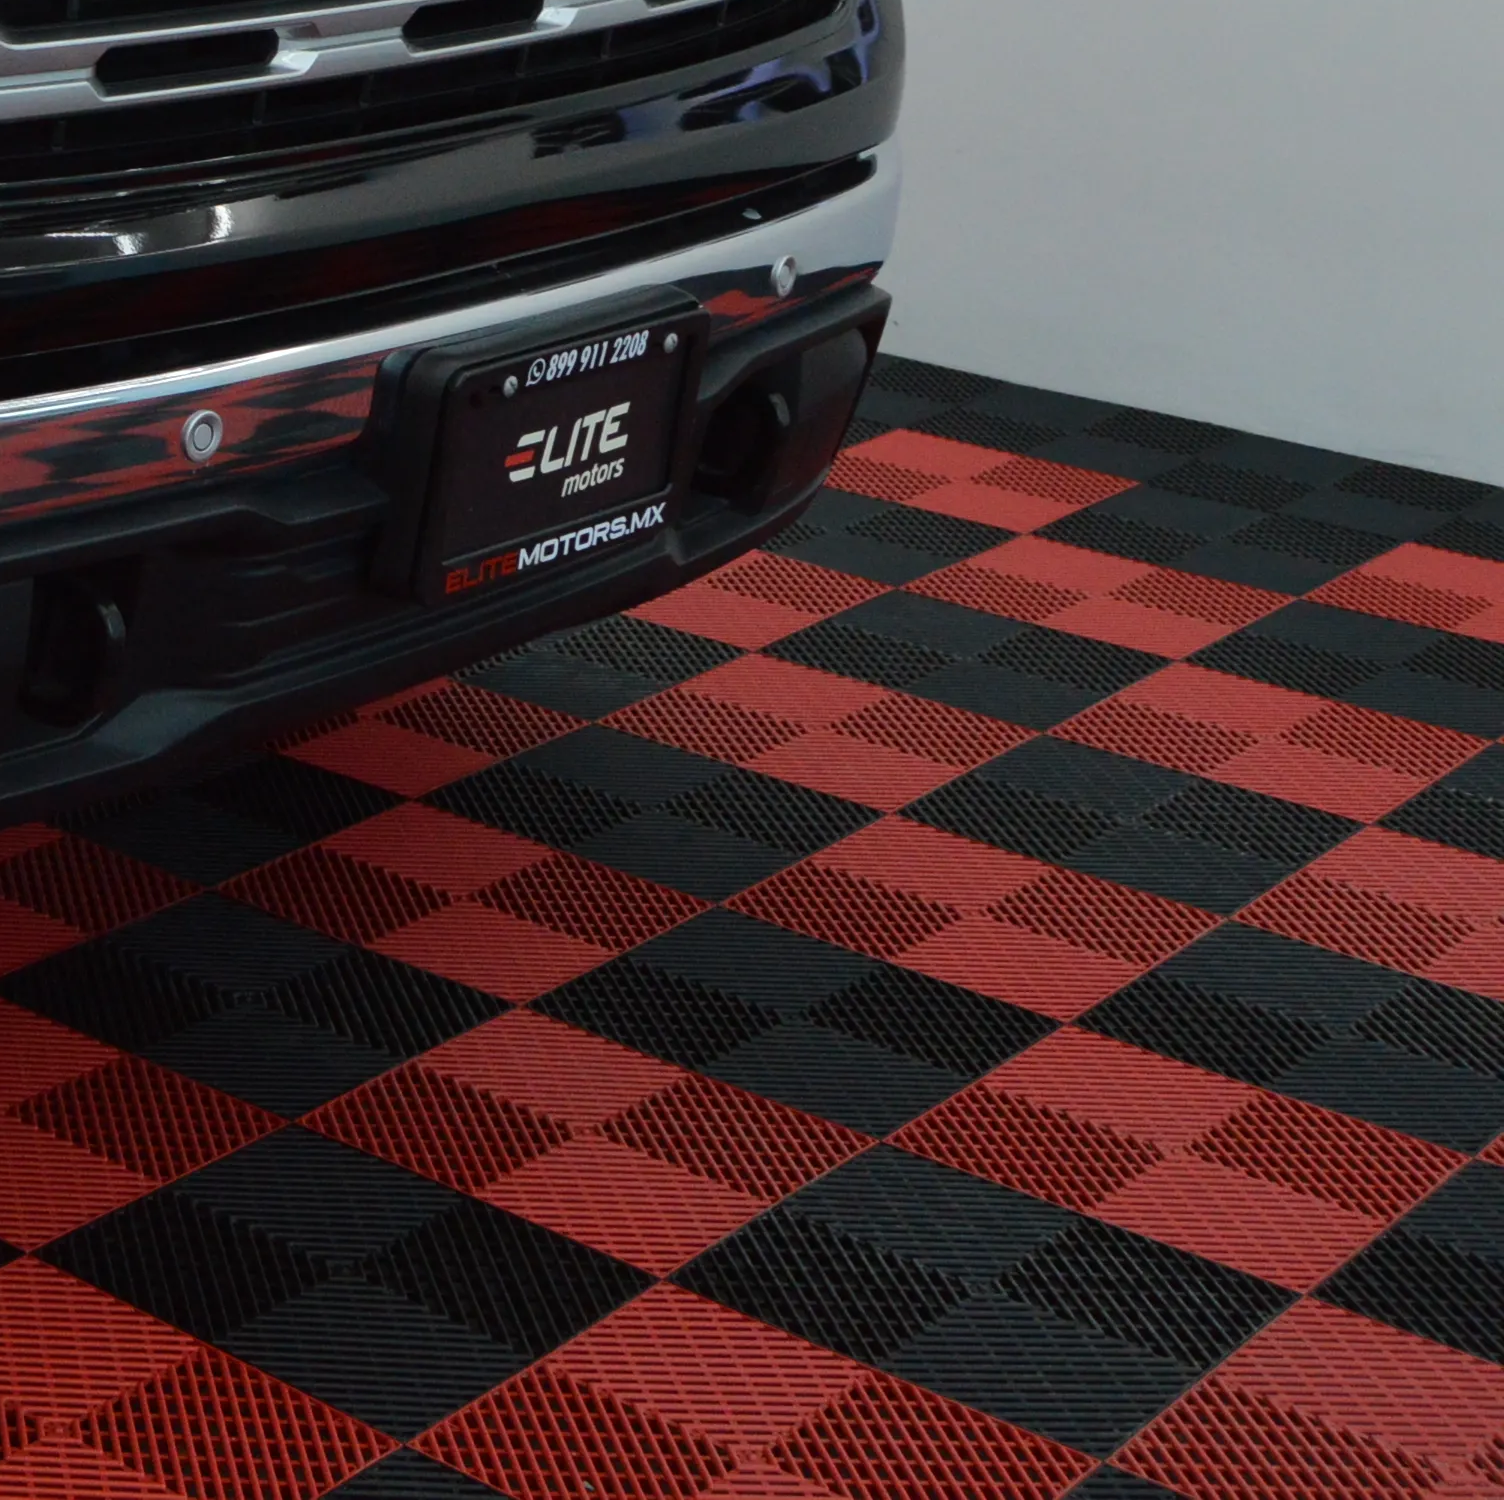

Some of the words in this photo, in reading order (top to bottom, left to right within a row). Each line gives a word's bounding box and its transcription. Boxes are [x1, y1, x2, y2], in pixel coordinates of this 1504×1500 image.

[546, 349, 578, 381] 899
[579, 341, 609, 372] 911
[609, 329, 649, 364] 2208
[504, 401, 631, 482] ELITE
[561, 457, 625, 498] motors
